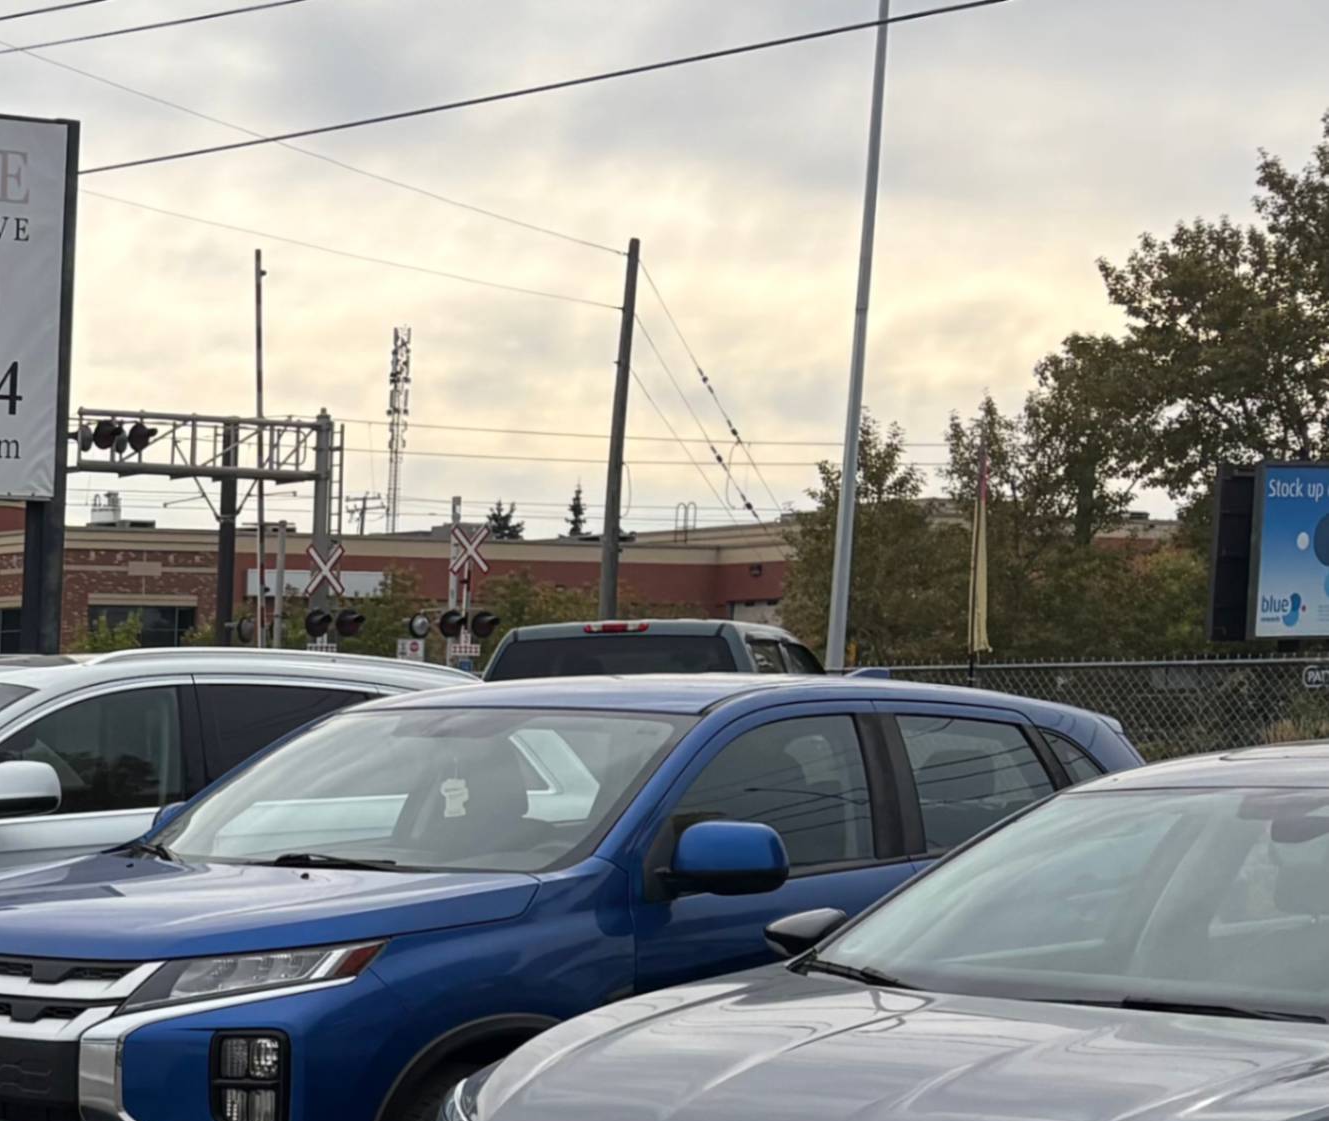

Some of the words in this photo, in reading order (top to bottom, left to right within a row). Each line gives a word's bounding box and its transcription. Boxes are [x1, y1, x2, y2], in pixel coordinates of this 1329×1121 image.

[1268, 478, 1304, 498] Stock
[1308, 483, 1324, 503] up
[1261, 595, 1290, 613] blue
